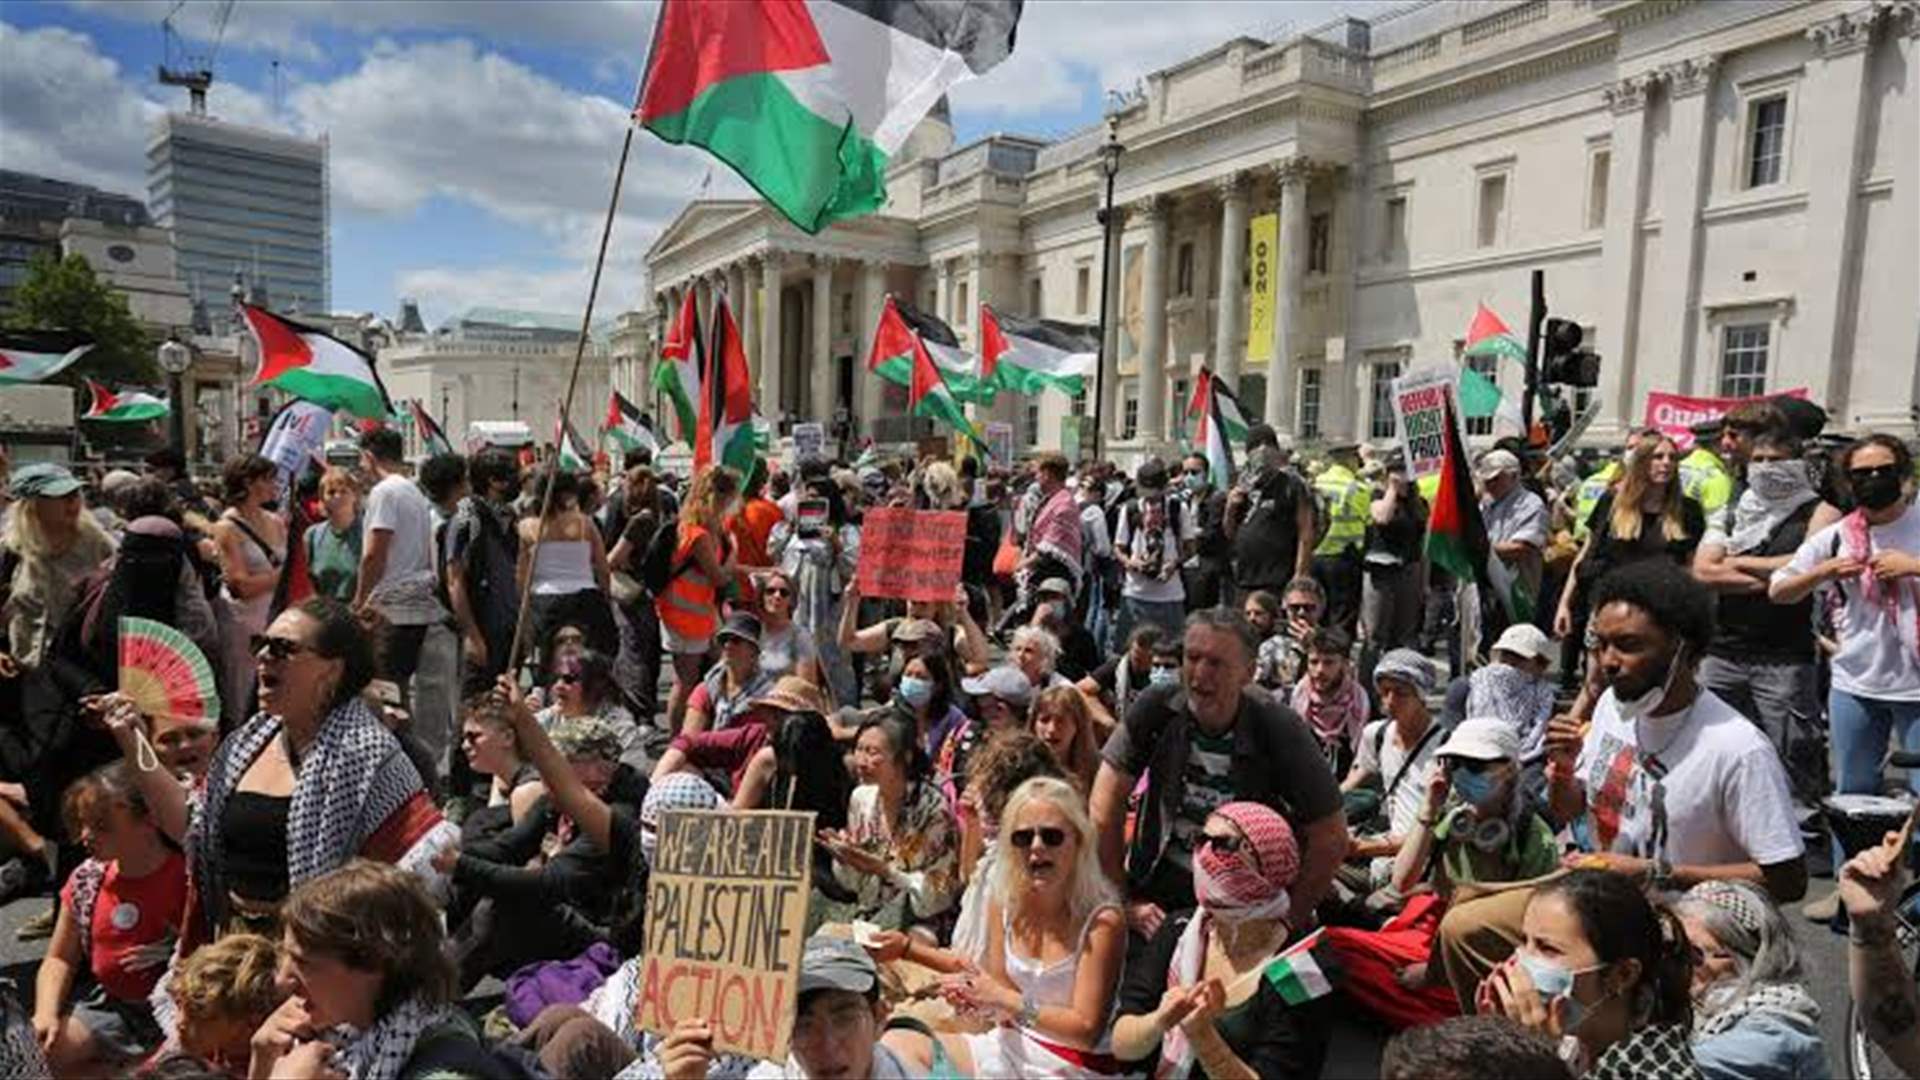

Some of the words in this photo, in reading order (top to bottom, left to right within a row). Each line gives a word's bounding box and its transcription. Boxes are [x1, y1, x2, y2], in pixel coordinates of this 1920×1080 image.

[1256, 241, 1267, 294] 200
[656, 818, 697, 873] WE
[702, 818, 753, 875] ARE
[755, 818, 804, 880] ALL
[649, 882, 798, 972] PALESTINE
[637, 957, 785, 1054] ACTION
